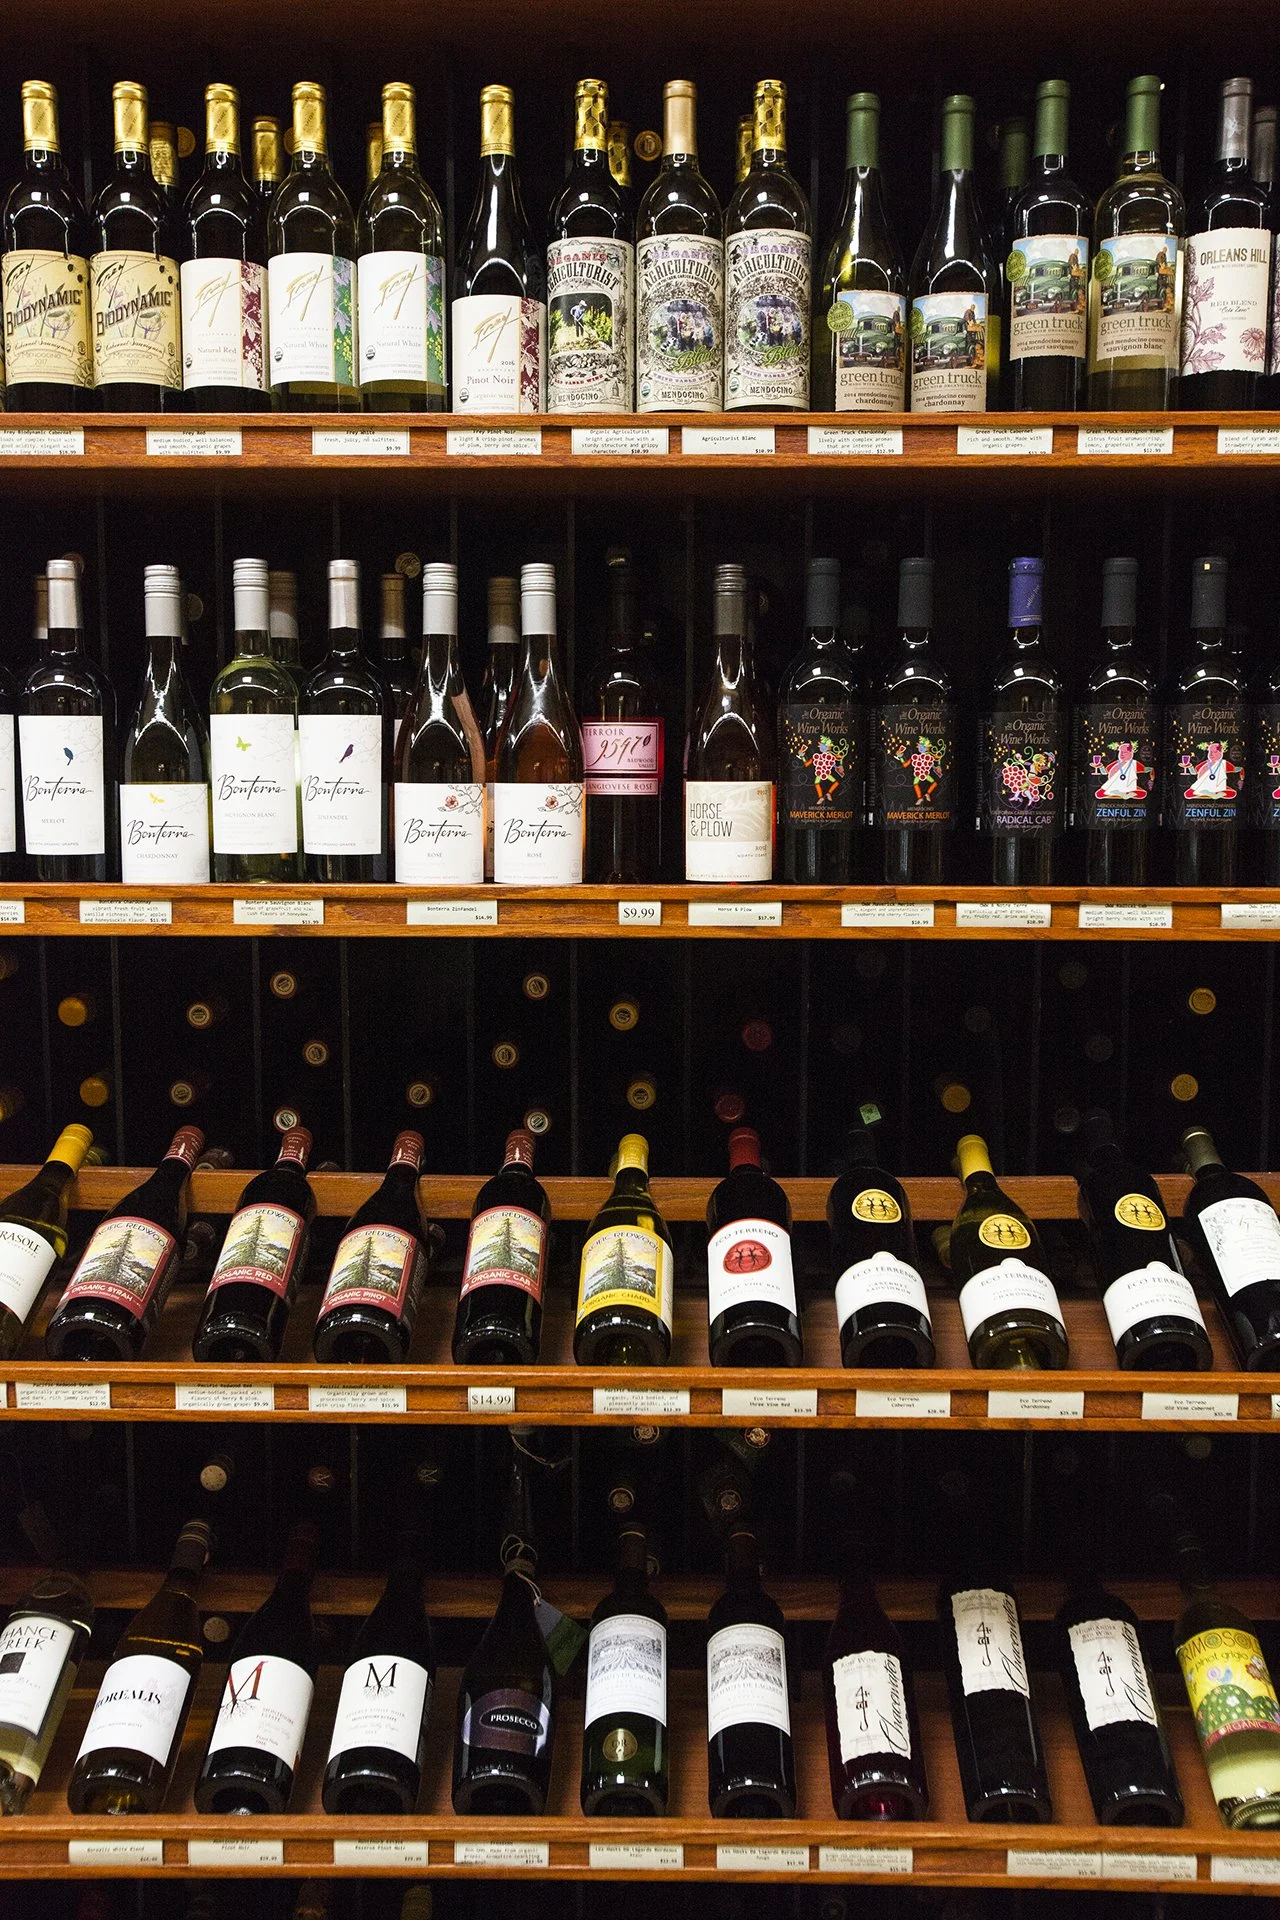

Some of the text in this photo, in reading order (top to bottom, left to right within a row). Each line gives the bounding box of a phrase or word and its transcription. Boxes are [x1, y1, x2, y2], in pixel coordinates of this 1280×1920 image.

[1200, 248, 1267, 266] ORLEANS HILL
[643, 258, 720, 291] AGRICULTURIST
[732, 253, 808, 286] AGRICULTURIST
[6, 290, 82, 337] BIODYNAMIC
[96, 290, 172, 337] BIODYNAMIC
[1013, 316, 1084, 336] green truck
[1100, 315, 1172, 336] green truck
[1106, 344, 1142, 353] sauvignon
[466, 376, 516, 385] Pinot Noir
[840, 372, 878, 386] green
[912, 370, 982, 392] green truck
[558, 393, 598, 402] MENDOCINO
[661, 391, 705, 400] MENDOCINO
[750, 386, 793, 394] MENDOCINO
[855, 397, 894, 407] chardonnay
[924, 400, 966, 408] chardonnay
[810, 708, 844, 724] Organic
[908, 708, 942, 724] Organic
[1112, 707, 1147, 724] Organic
[1200, 707, 1236, 724] Organic
[584, 728, 624, 736] TERROIR
[796, 722, 848, 734] Wine Works
[895, 724, 946, 734] Wine Works
[1012, 720, 1047, 736] Organic
[1098, 722, 1150, 734] Wine Works
[1187, 722, 1240, 734] Wine Works
[1000, 733, 1050, 744] Wine Works
[24, 774, 94, 802] Bonterra
[217, 774, 286, 801] Bonterra
[304, 774, 370, 802] Bonterra
[690, 803, 722, 820] HORSE
[790, 810, 853, 820] MAVERICK MERLOT
[886, 811, 950, 821] MAVERICK MERLOT
[996, 814, 1034, 824] RADICAL
[1096, 808, 1147, 818] ZENFUL ZIN
[1186, 808, 1236, 818] ZENFUL ZIN
[127, 820, 196, 846] Bonterra
[403, 818, 472, 844] Bonterra
[503, 818, 572, 844] Bonterra
[623, 908, 655, 918] $9.99
[126, 1222, 170, 1252] REDWOOD
[614, 1232, 660, 1254] REDWOOD
[716, 1228, 778, 1247] ECO TERRENO
[216, 1268, 273, 1283] ORGANIC RED
[471, 1272, 530, 1286] ORGANIC CAB
[852, 1266, 918, 1282] ECO TERRENO
[980, 1272, 1048, 1288] ECO TERRENO
[72, 1284, 134, 1302] ORGANIC SYRAH
[328, 1290, 386, 1304] ORGANIC PINOT
[472, 1394, 511, 1406] $14.99
[364, 1662, 398, 1694] M
[96, 1689, 162, 1712] BOREALIS
[490, 1714, 538, 1730] PROSECCO
